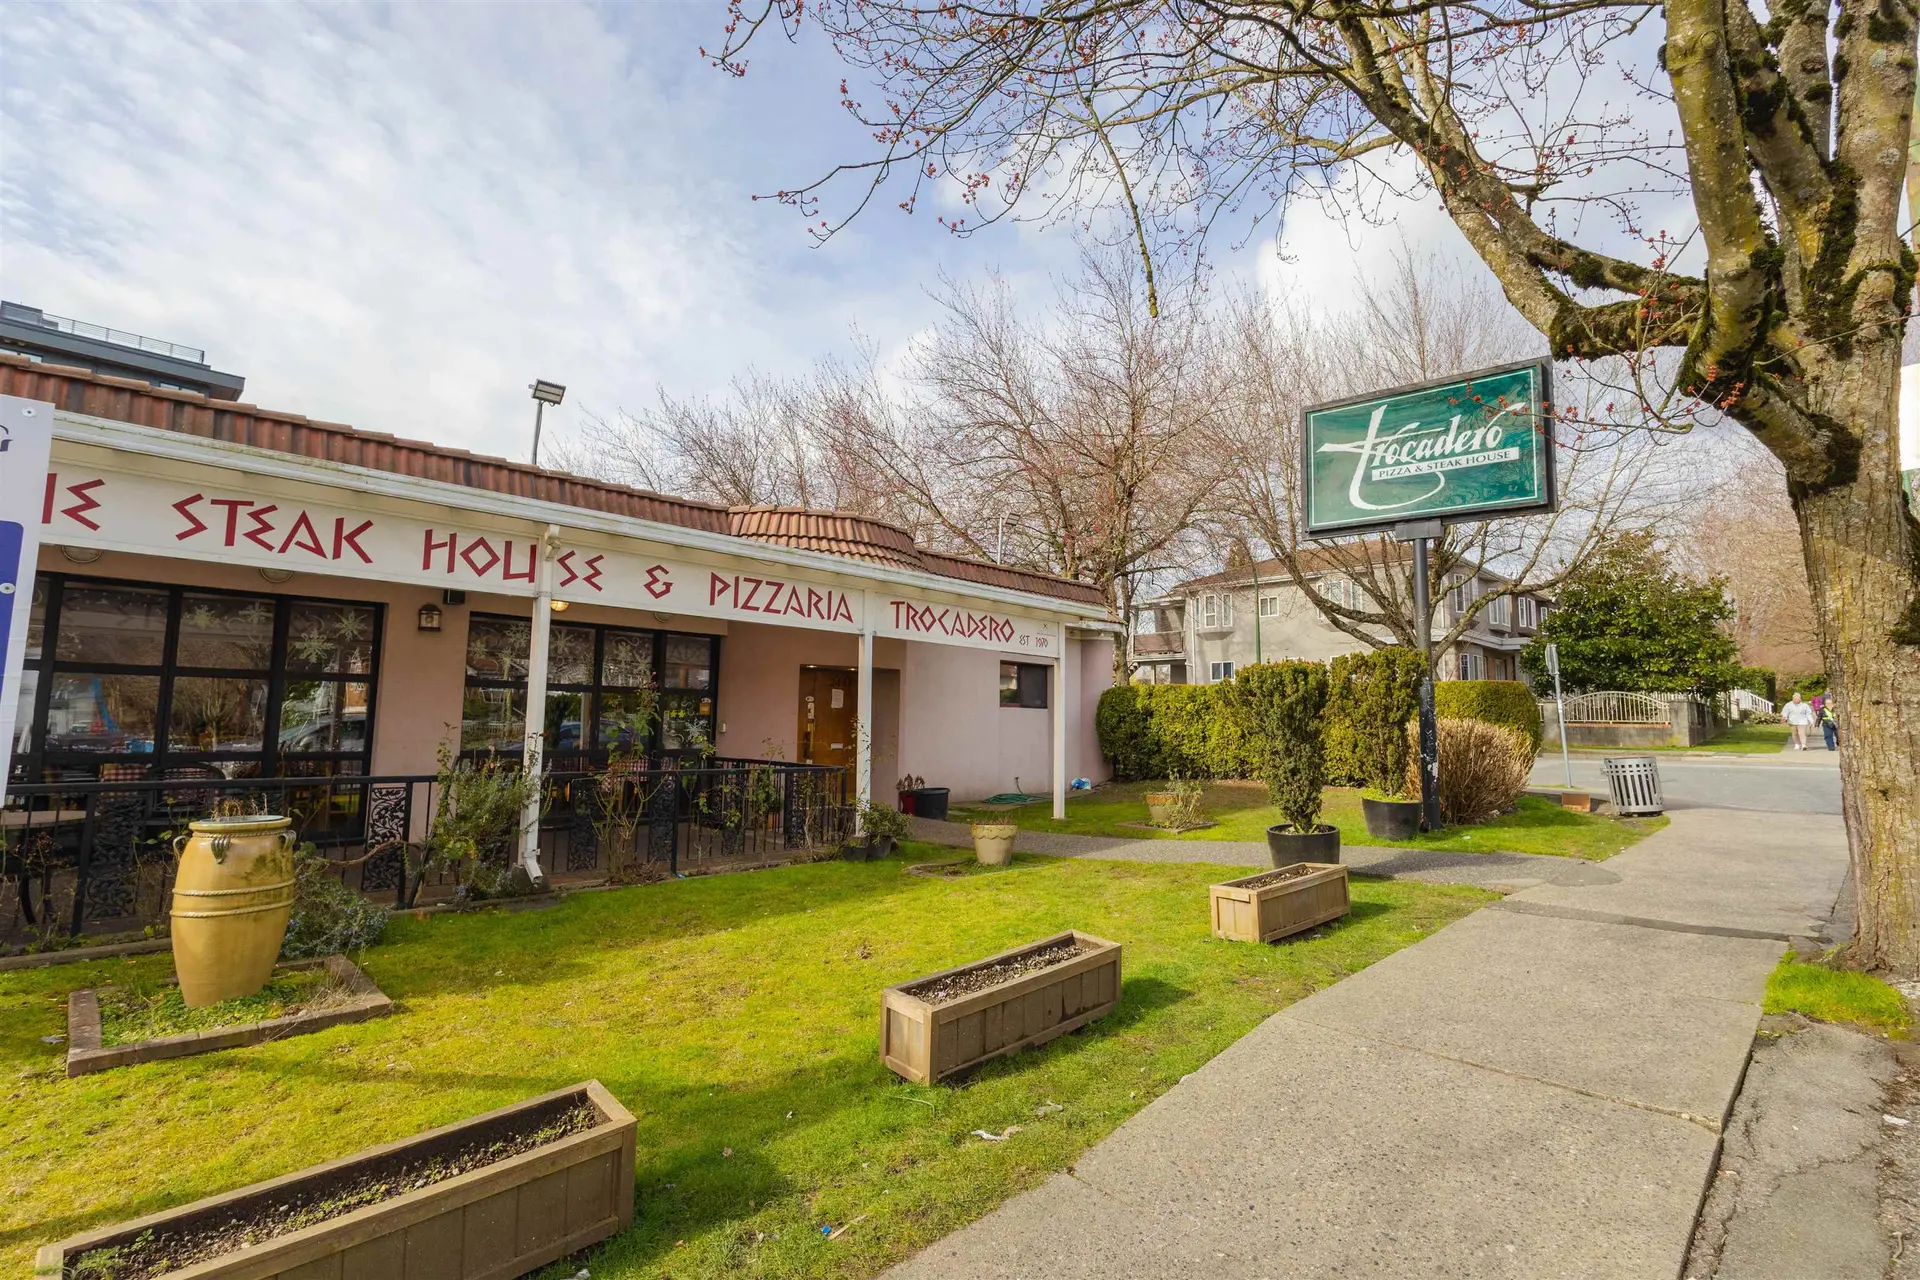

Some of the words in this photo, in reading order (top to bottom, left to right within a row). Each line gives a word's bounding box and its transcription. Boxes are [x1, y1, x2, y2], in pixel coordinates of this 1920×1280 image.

[1378, 467, 1412, 478] PIZZA
[1415, 465, 1424, 473] &
[1427, 458, 1463, 471] STEAK
[1466, 450, 1511, 465] HOUSE
[171, 493, 374, 565] STEAK
[422, 528, 605, 592] HOUSE
[643, 564, 674, 599] &
[709, 571, 854, 624] PIZZARIA
[890, 600, 1016, 643] TROCADERO
